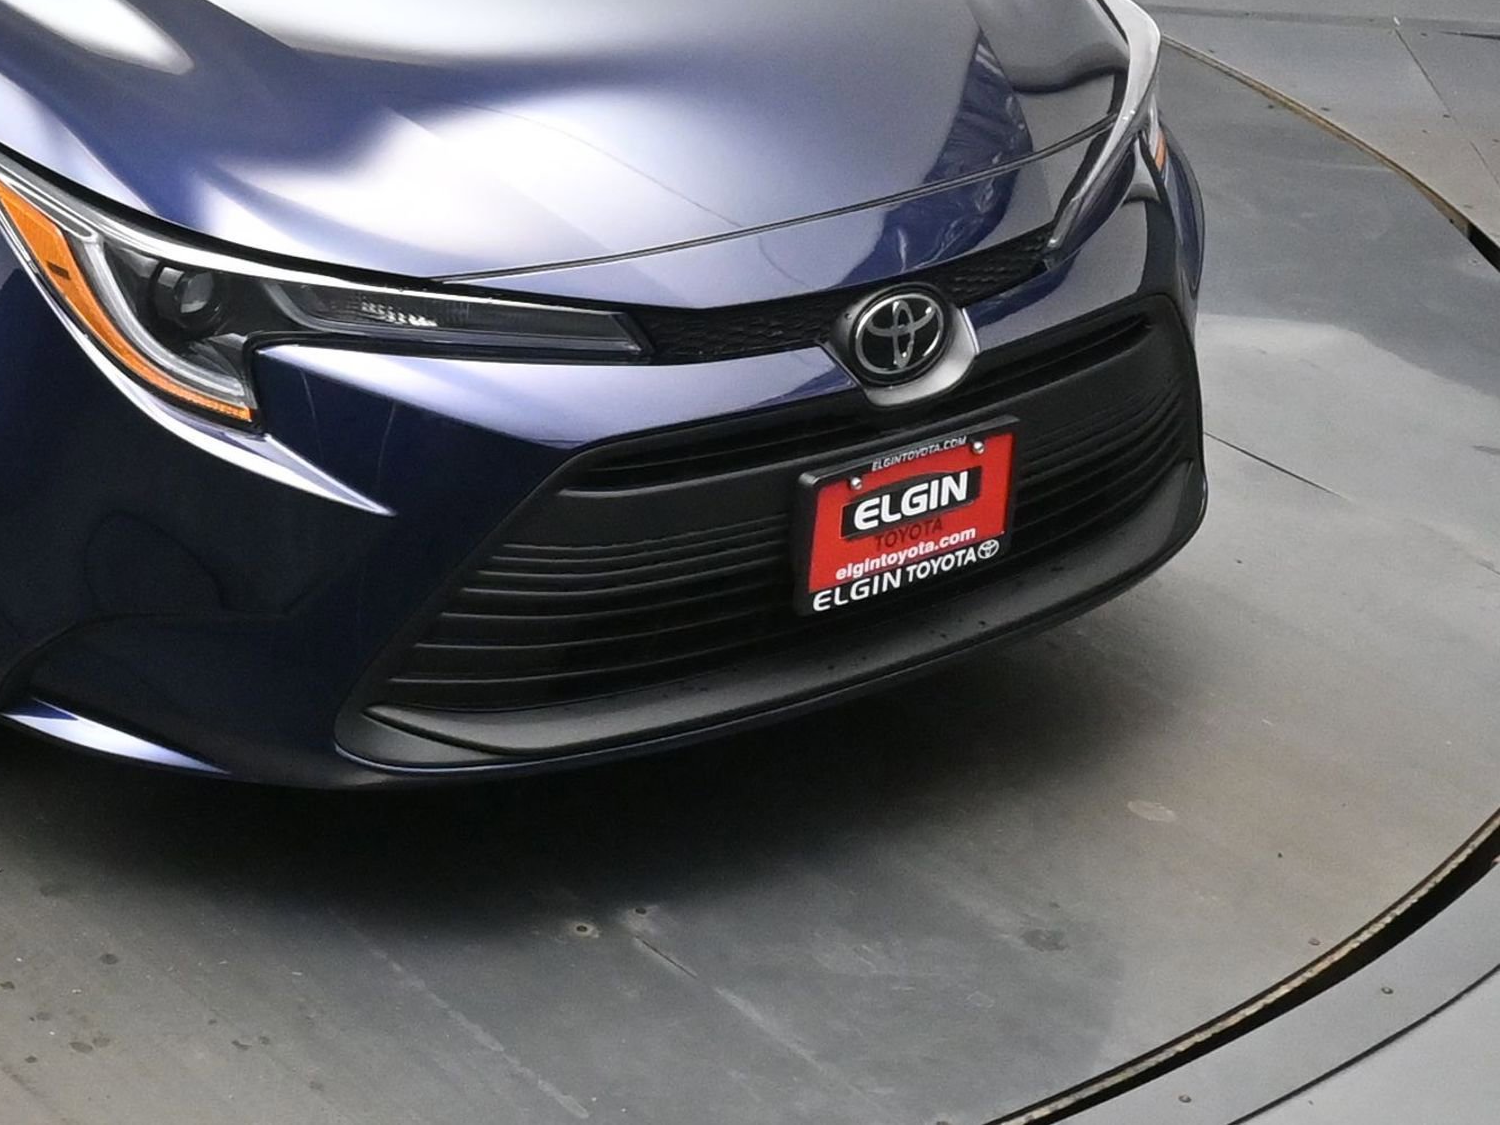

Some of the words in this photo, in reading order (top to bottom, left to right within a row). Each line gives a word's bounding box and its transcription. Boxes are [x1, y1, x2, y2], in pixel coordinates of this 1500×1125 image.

[872, 436, 967, 471] ELGINTOYOTA.COM
[854, 471, 968, 530] ELGIN
[835, 528, 976, 580] elgintoyota.com
[876, 518, 943, 550] TOYOTA
[813, 569, 902, 612] ELGIN
[906, 549, 977, 582] TOYOTA
